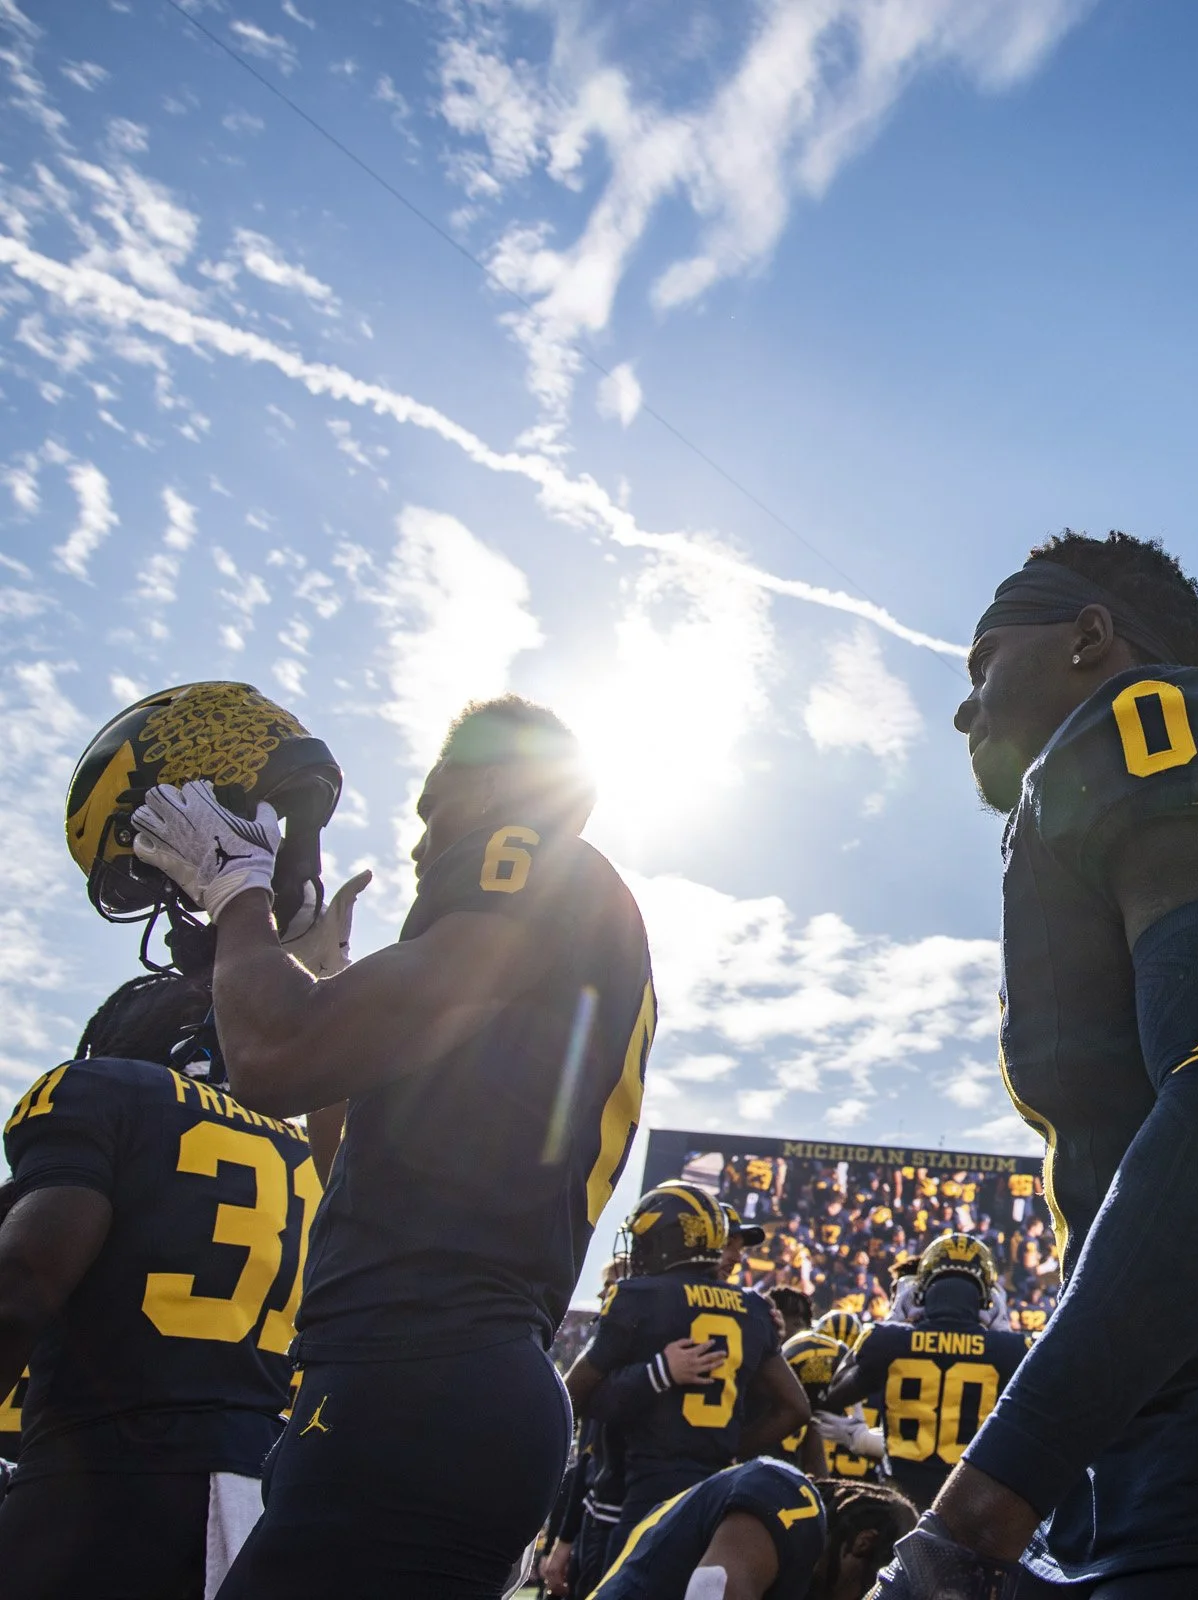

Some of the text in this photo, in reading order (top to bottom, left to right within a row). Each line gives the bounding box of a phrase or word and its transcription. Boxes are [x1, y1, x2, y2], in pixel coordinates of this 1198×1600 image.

[1112, 680, 1197, 777] 0
[480, 826, 540, 893] 6
[783, 1142, 1017, 1172] MICHIGAN STADIUM
[141, 1120, 324, 1356] 31
[684, 1284, 747, 1313] MOORE
[911, 1331, 985, 1355] DENNIS
[885, 1358, 999, 1464] 80
[777, 1485, 819, 1530] 7
